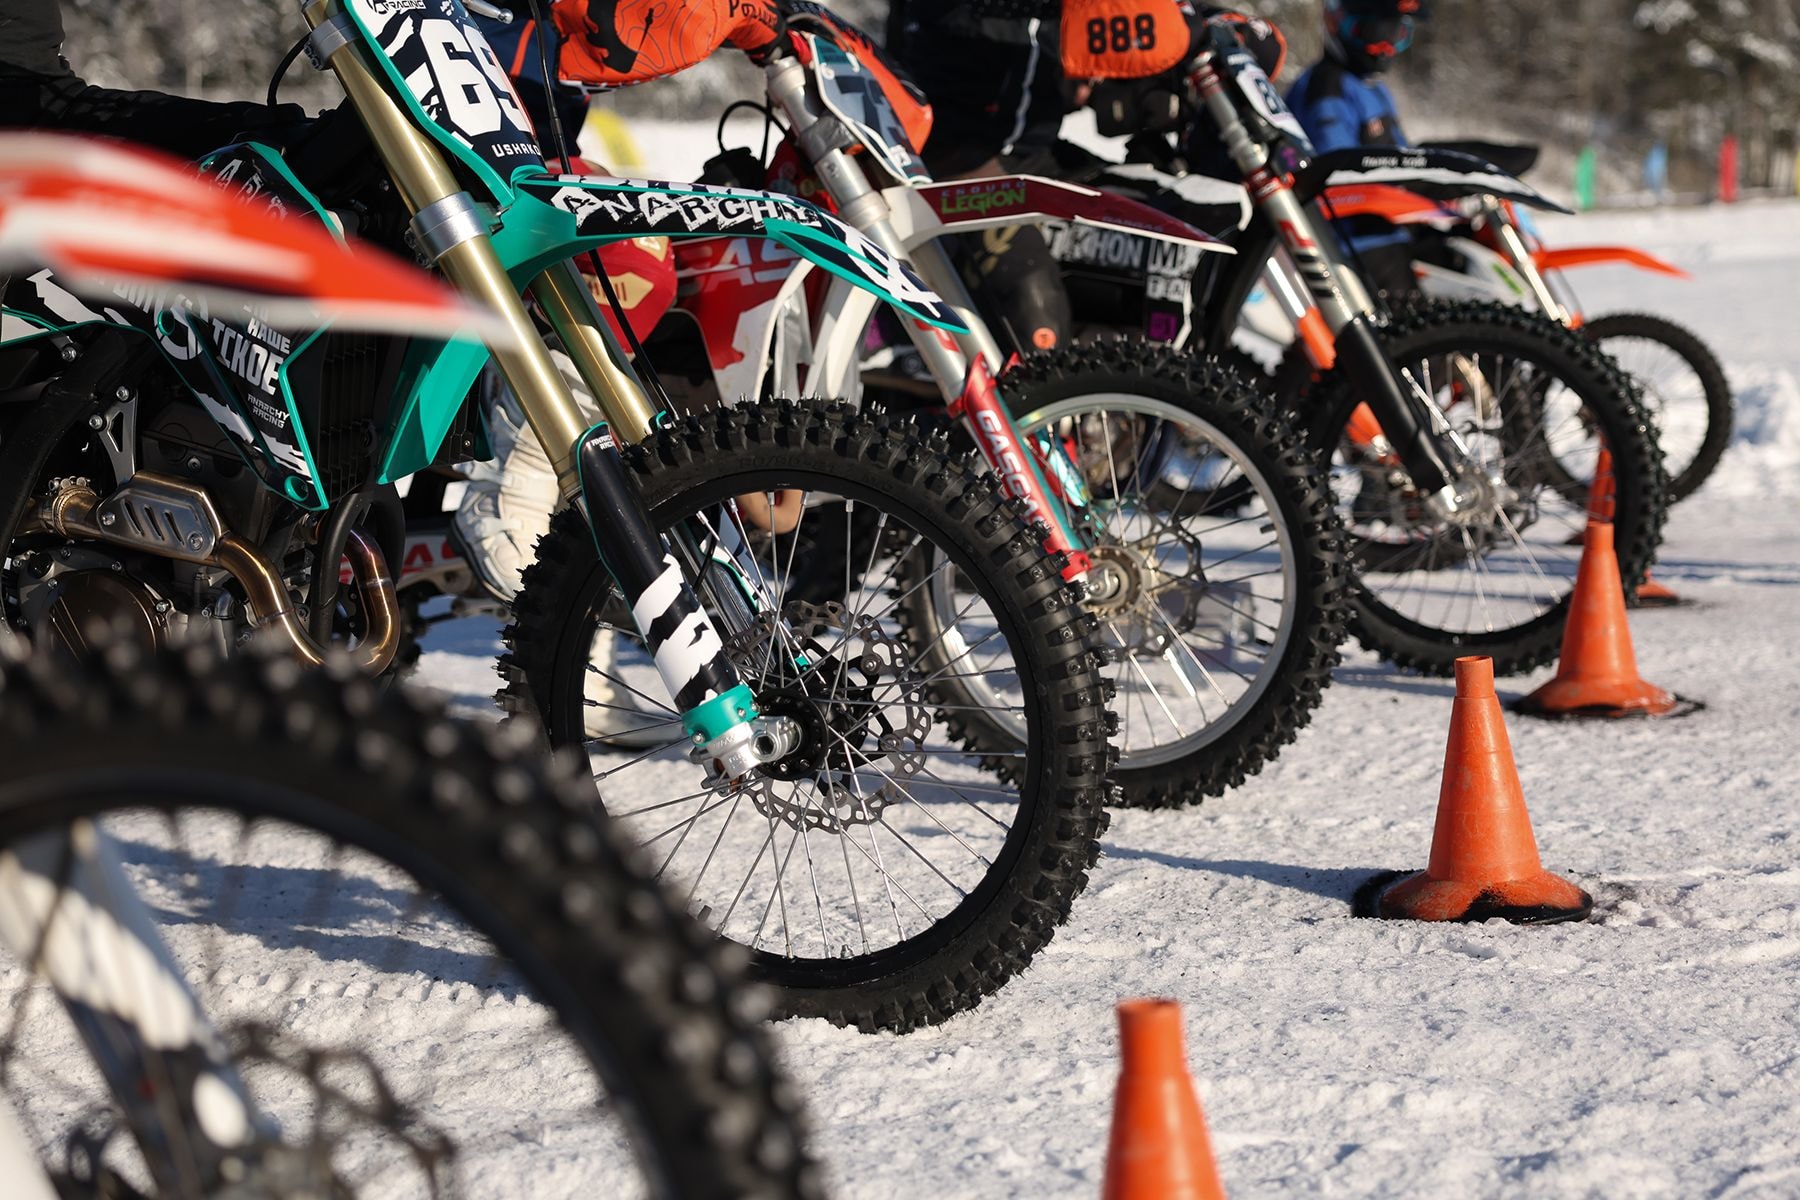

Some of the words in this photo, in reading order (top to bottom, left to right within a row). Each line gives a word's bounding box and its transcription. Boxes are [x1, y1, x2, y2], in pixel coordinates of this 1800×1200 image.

[1087, 14, 1156, 54] 888
[419, 18, 534, 137] 69
[551, 186, 822, 232] ANARCHY
[941, 188, 1025, 216] LEGION
[246, 317, 290, 355] НАШЕ
[247, 393, 290, 422] ANARCHY
[252, 406, 285, 429] RACING
